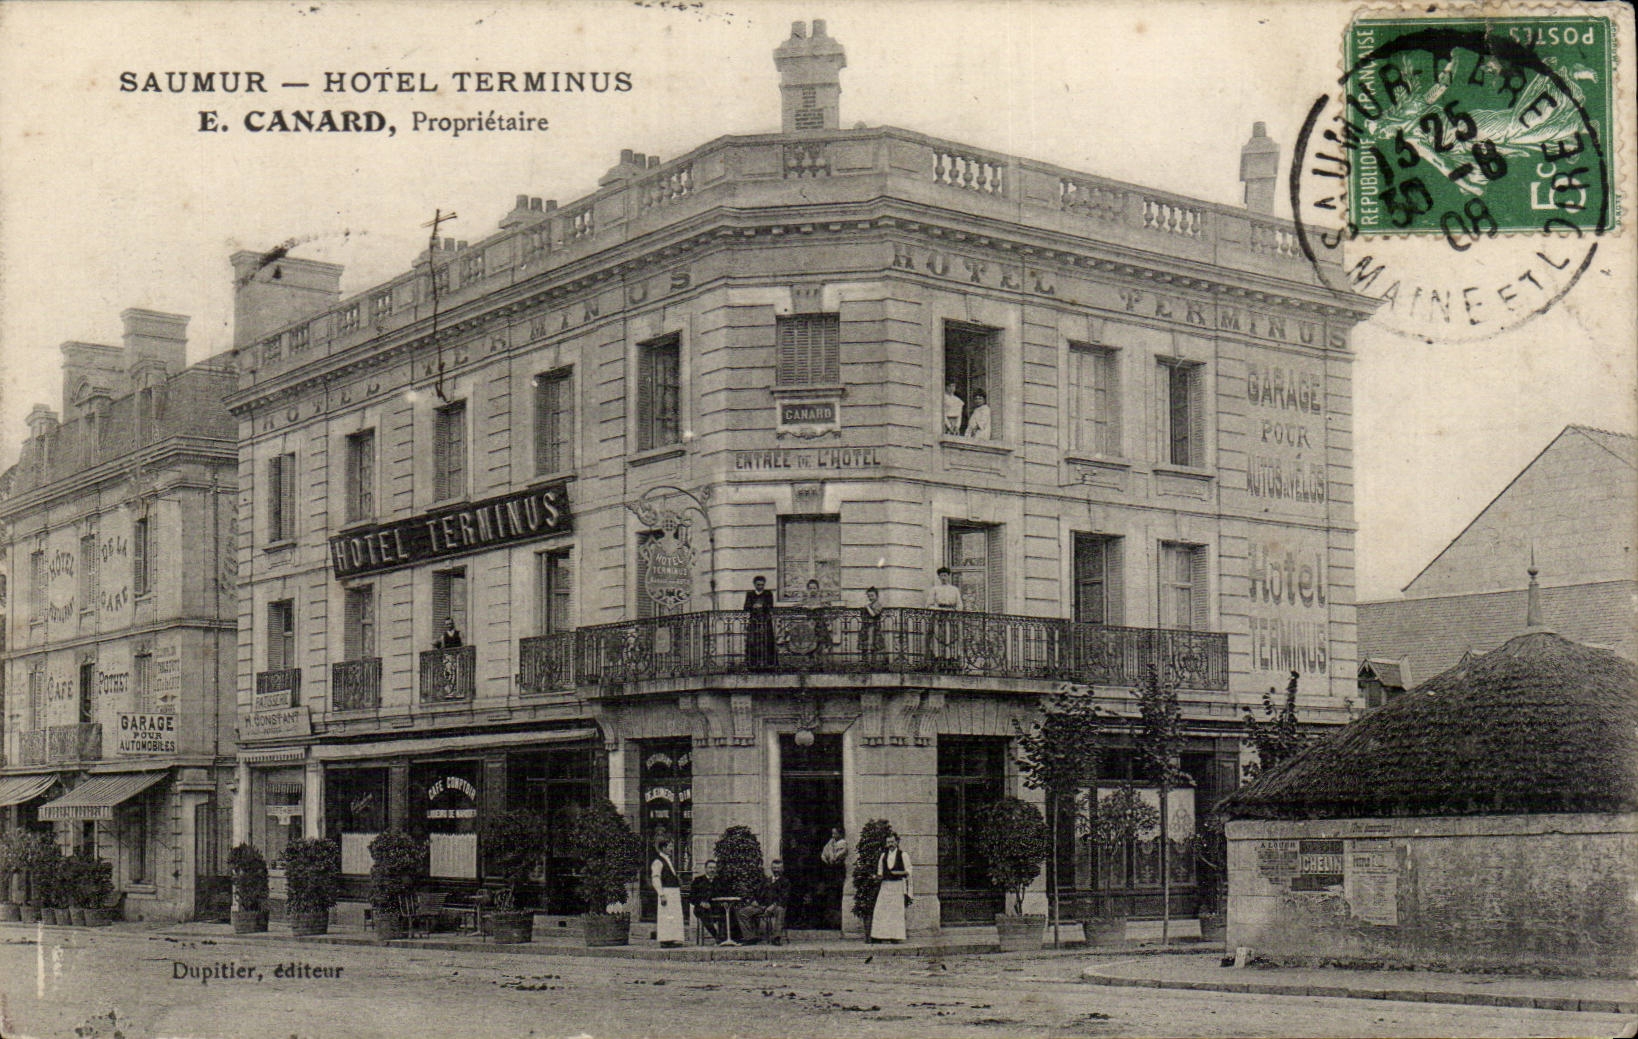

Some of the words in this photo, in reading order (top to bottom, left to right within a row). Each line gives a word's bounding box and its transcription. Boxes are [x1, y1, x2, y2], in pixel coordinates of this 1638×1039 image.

[1509, 26, 1595, 45] POSTES
[1247, 366, 1321, 415] GARAGE
[785, 407, 832, 421] CANARD
[1261, 419, 1312, 449] POUR
[336, 529, 409, 571] HOTEL
[426, 491, 560, 551] TERMINUS
[655, 552, 683, 567] HOTEL
[652, 566, 687, 577] TERMINUS
[101, 586, 128, 612] GARE
[1249, 617, 1327, 675] TERMINUS
[120, 715, 174, 732] GARAGE
[254, 710, 300, 727] CONSTANT
[133, 731, 162, 739] POUR
[120, 740, 175, 752] AUTOMOBILES
[446, 776, 477, 801] COMPTOIR
